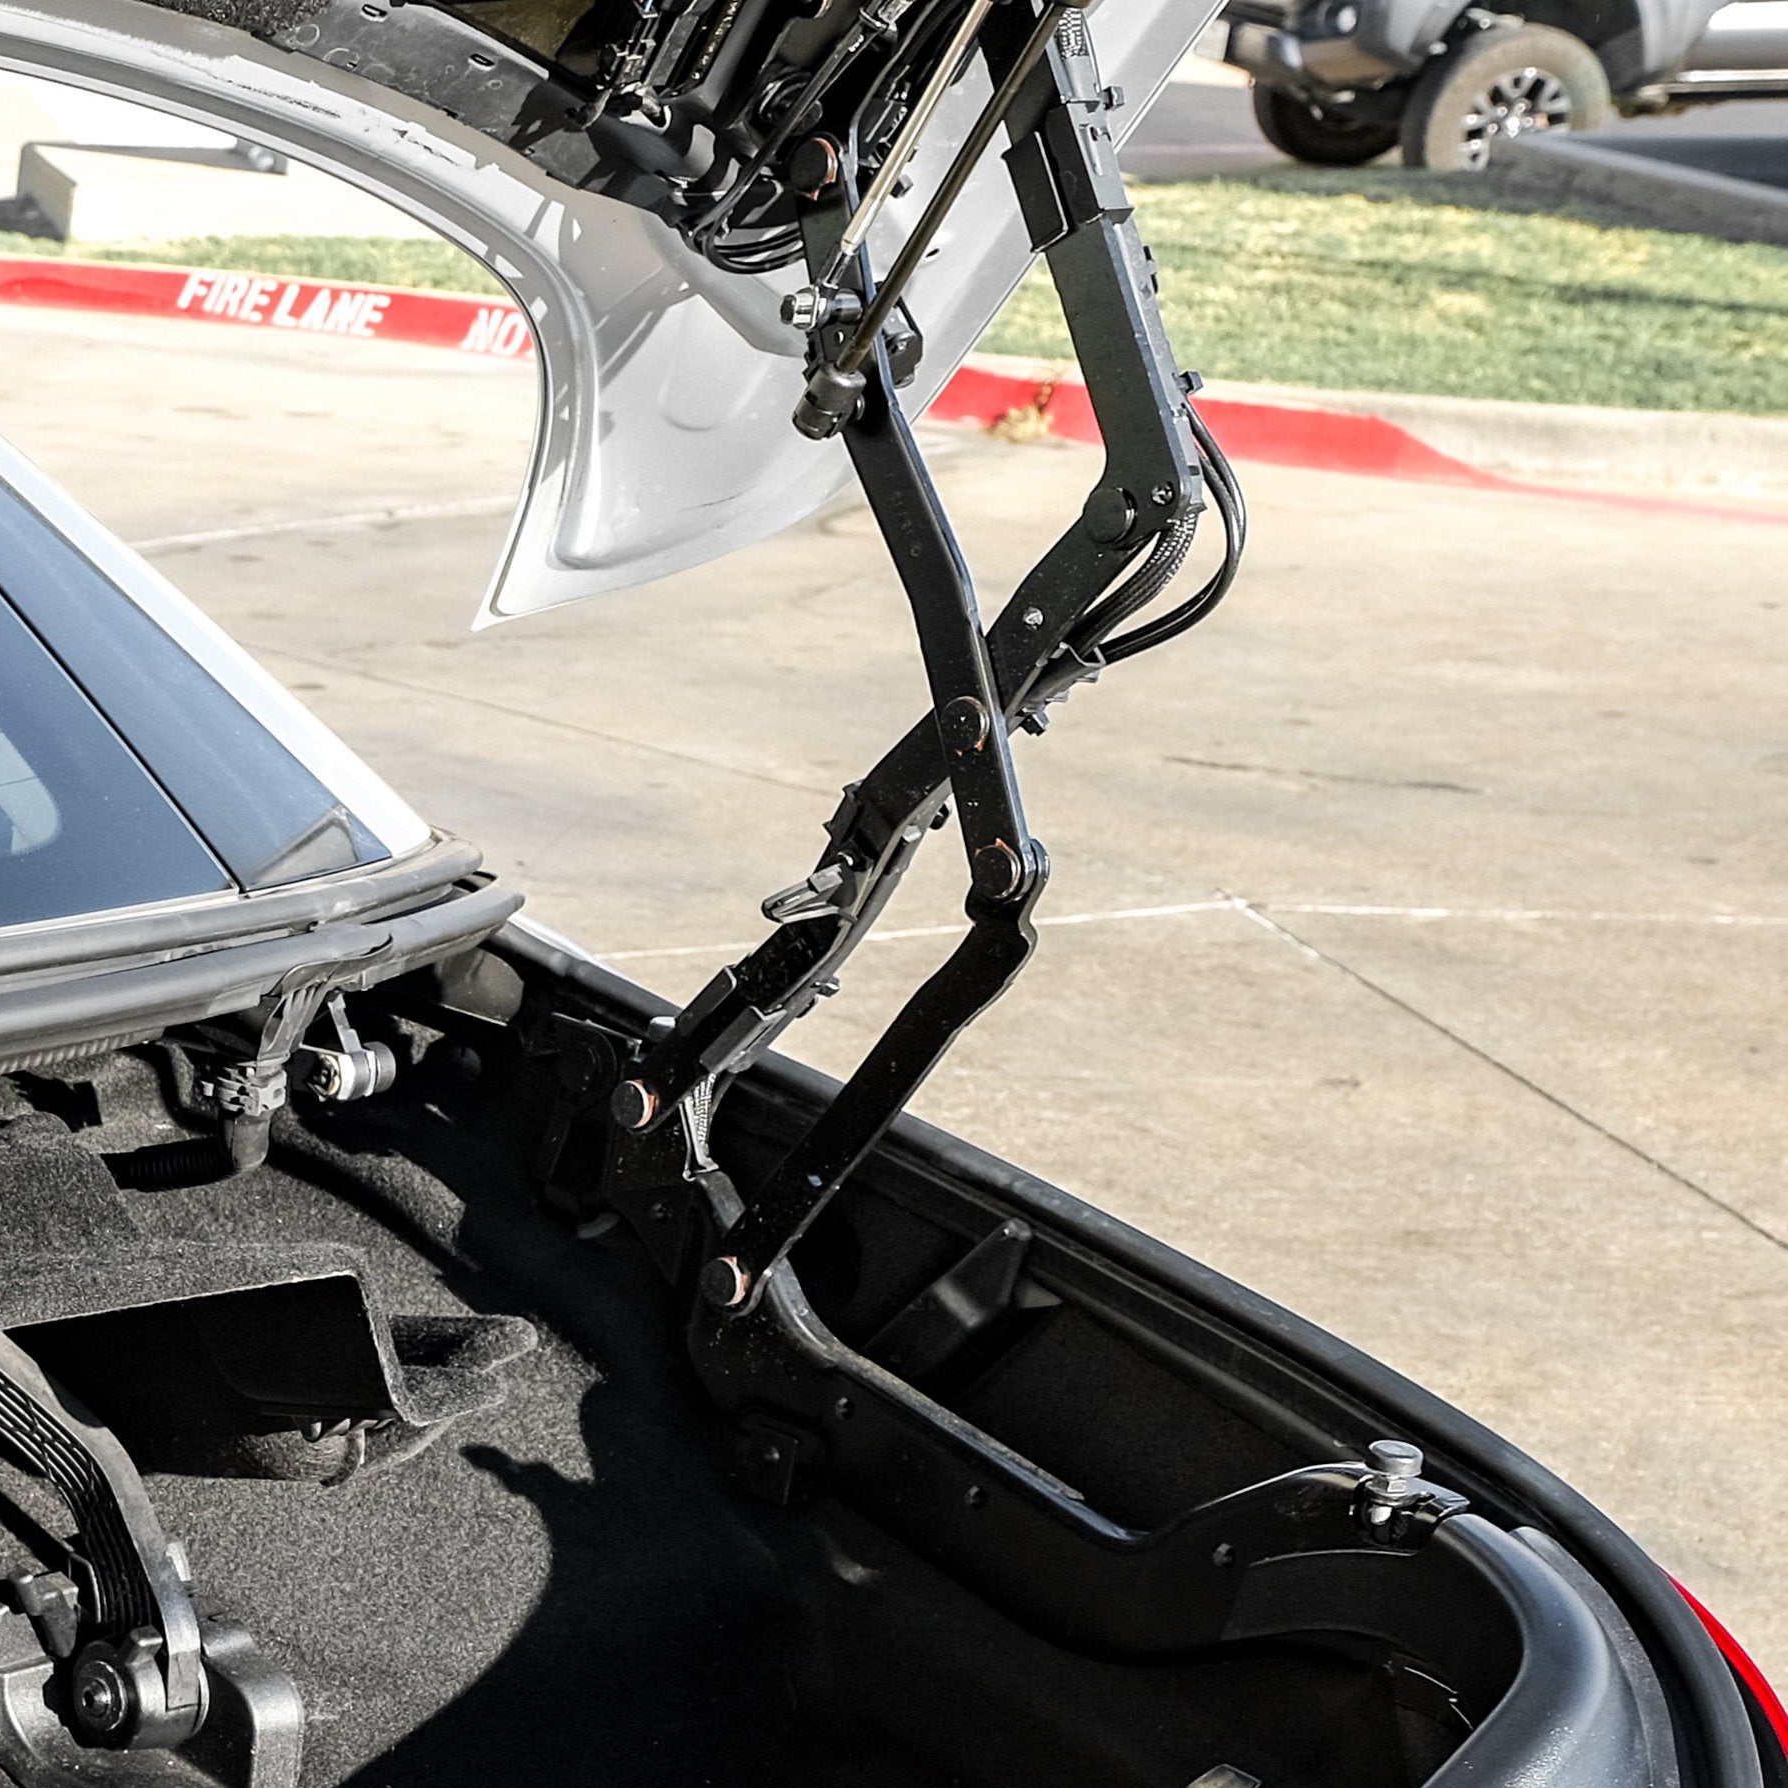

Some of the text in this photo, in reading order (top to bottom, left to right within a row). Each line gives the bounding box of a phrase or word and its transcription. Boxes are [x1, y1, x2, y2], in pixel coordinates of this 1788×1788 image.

[176, 271, 528, 355] FIRE LANE NO
